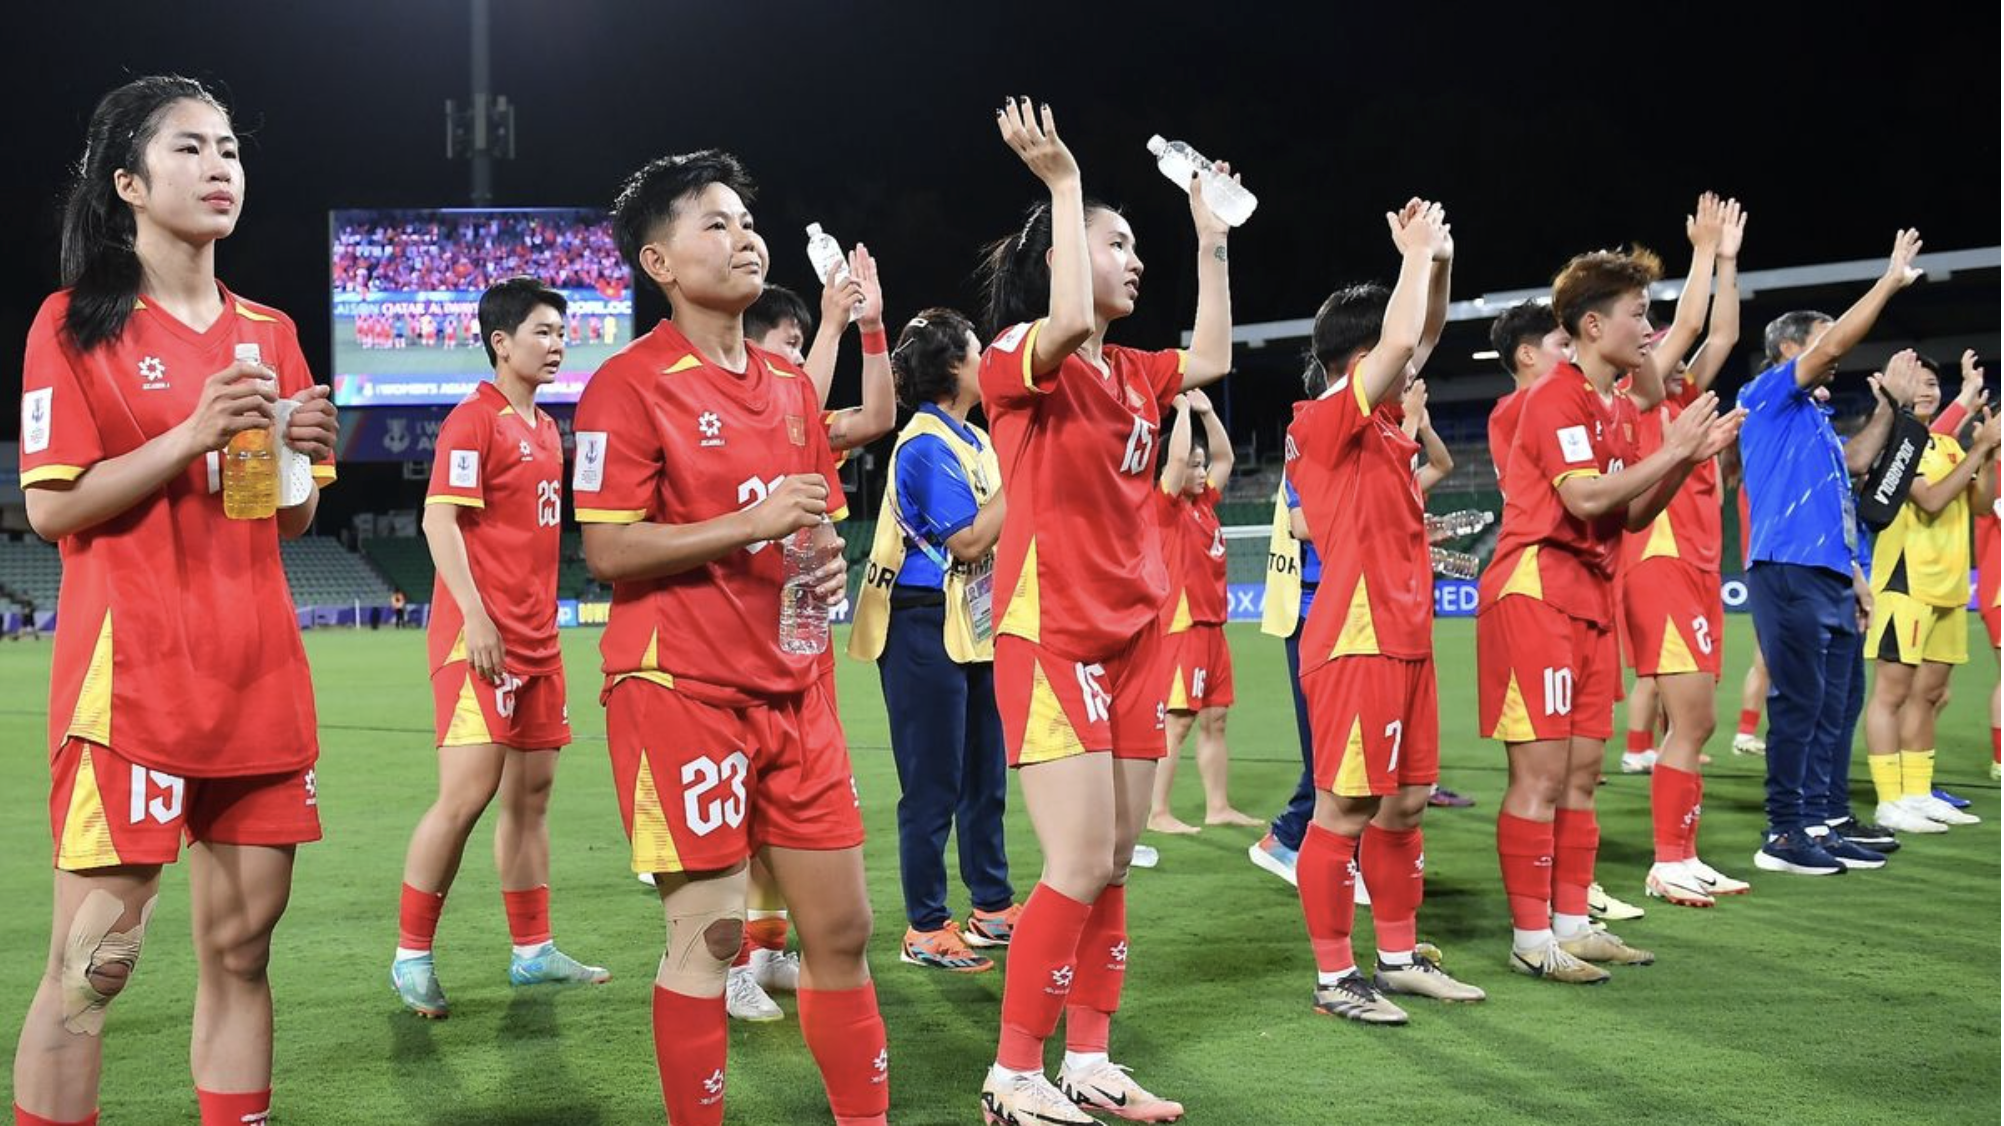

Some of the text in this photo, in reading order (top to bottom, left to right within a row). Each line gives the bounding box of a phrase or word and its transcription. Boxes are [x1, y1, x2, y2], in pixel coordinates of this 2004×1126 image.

[1120, 414, 1156, 475] 15
[537, 480, 561, 527] 25
[866, 560, 896, 589] OR
[1692, 615, 1712, 655] 2
[1191, 667, 1206, 699] 16
[1543, 666, 1572, 717] 10
[1384, 719, 1402, 773] 7
[680, 751, 749, 837] 23
